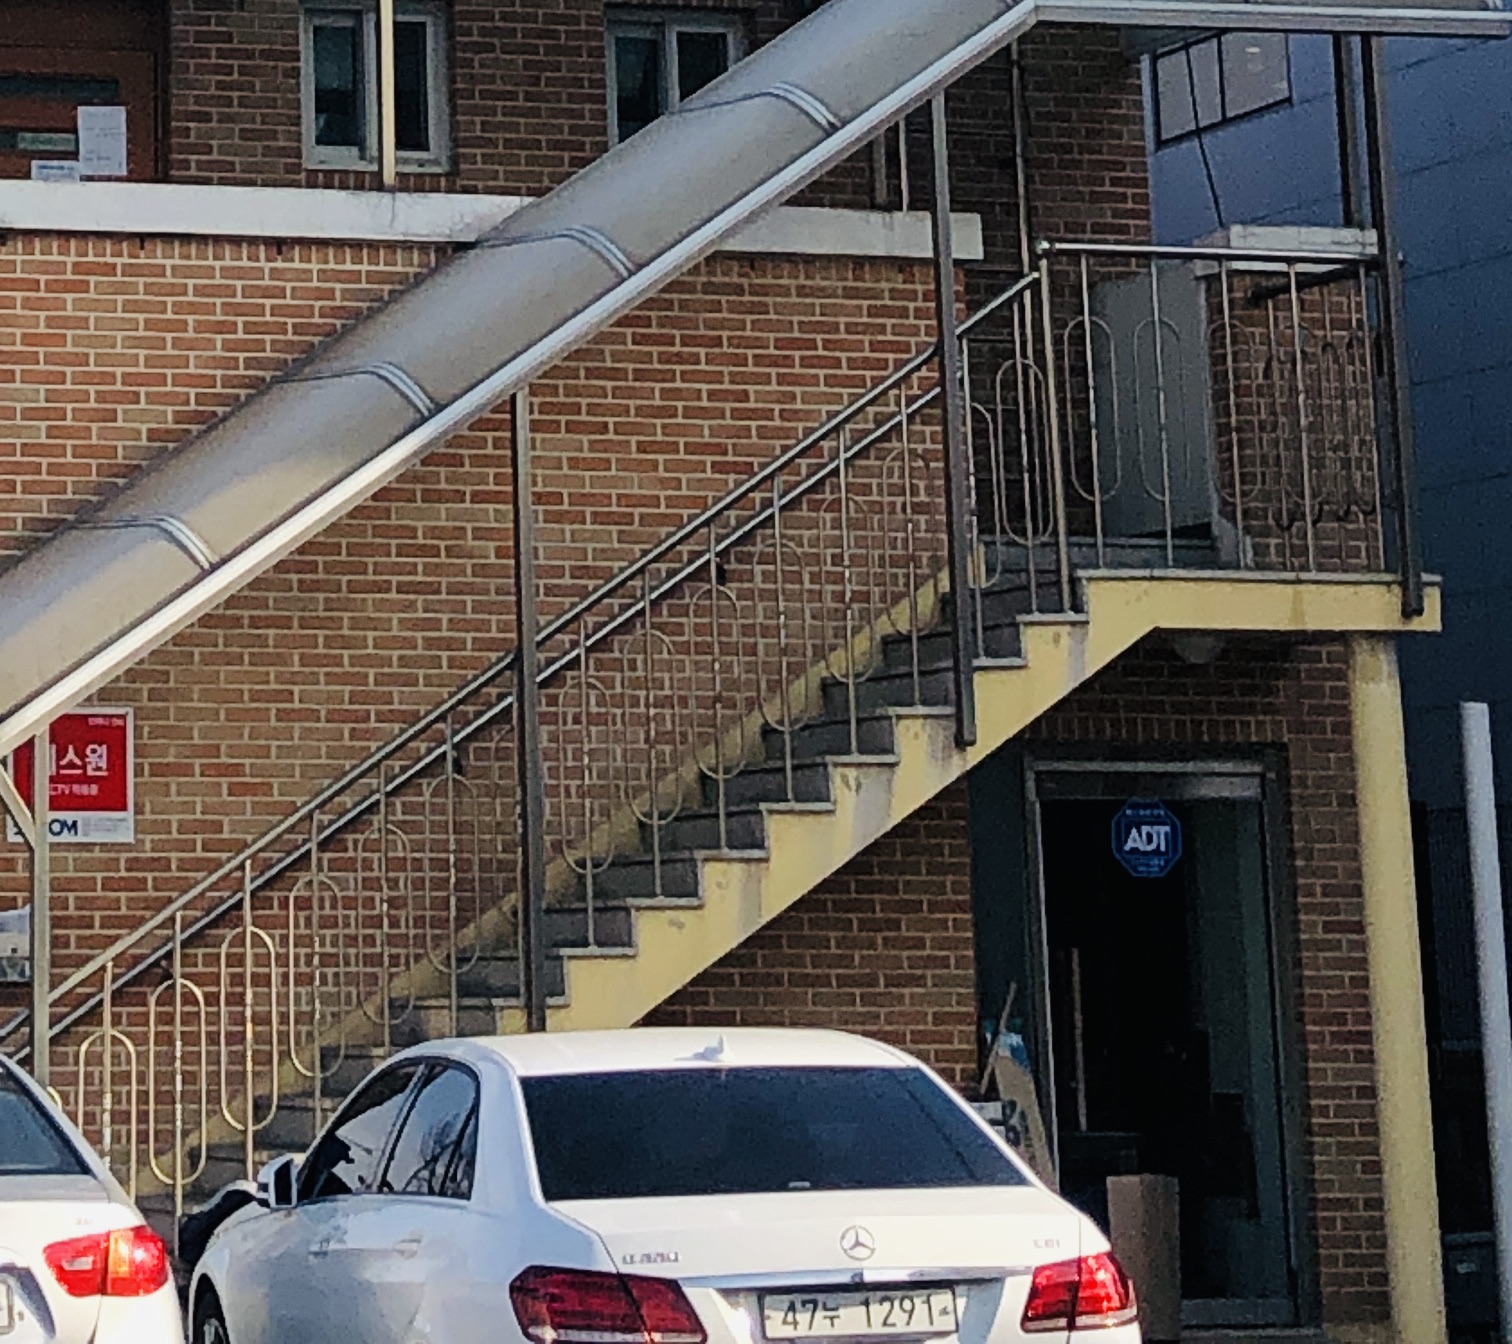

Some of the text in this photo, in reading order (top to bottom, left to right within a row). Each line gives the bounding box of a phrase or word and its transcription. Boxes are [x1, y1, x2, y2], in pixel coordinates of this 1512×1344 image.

[1123, 825, 1171, 852] ADT
[781, 1294, 935, 1332] 47누 1291
